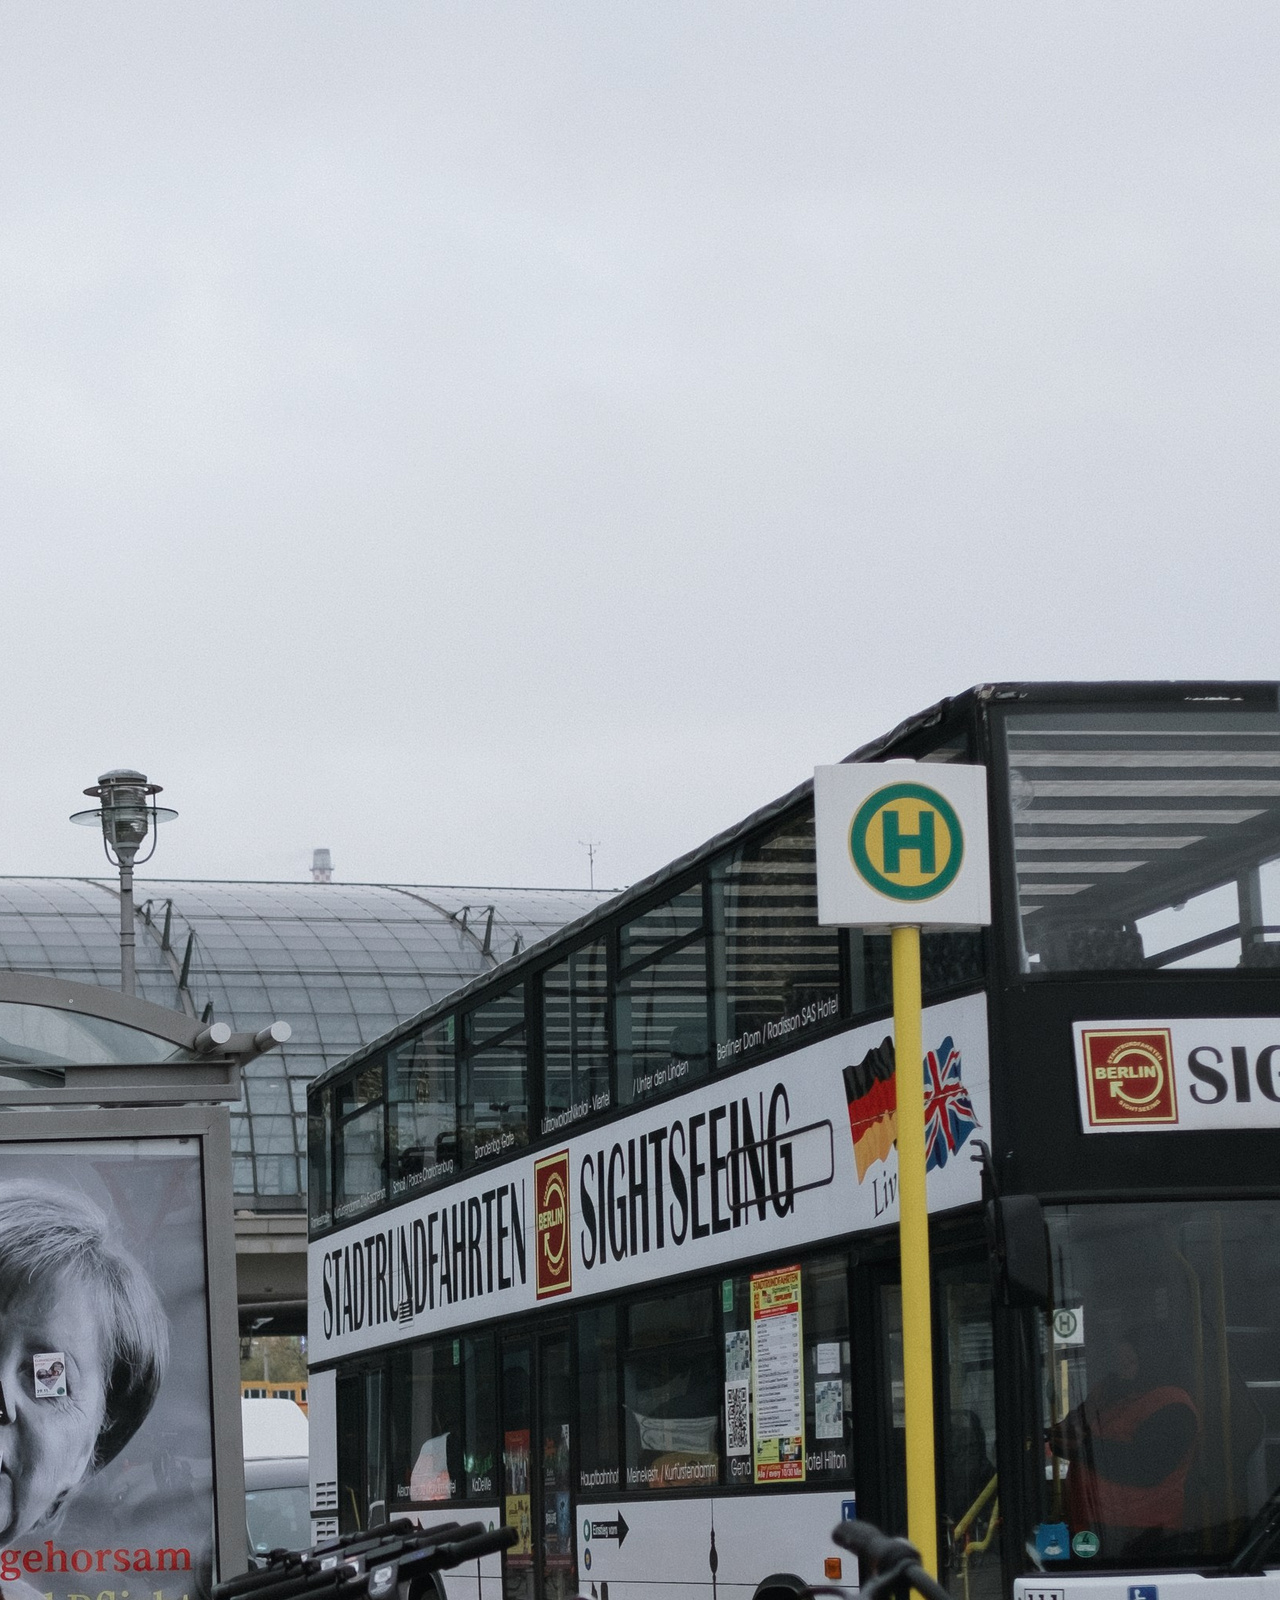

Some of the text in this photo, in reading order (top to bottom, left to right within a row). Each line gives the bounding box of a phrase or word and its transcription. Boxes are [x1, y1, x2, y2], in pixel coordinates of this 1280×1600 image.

[882, 810, 936, 874] H
[716, 1037, 742, 1061] Berliner
[743, 1029, 761, 1050] Dom
[767, 1013, 800, 1041] Radisson
[801, 1005, 817, 1026] SAS
[817, 994, 839, 1020] Hotel
[636, 1074, 653, 1095] Unter
[654, 1068, 667, 1089] den
[667, 1059, 689, 1084] Linden
[1095, 1066, 1156, 1080] BERLIN
[580, 1083, 795, 1271] SIGHTSEEING
[538, 1206, 564, 1231] BERLIN
[323, 1178, 527, 1340] STADTRUNDFAHRTEN
[580, 1468, 620, 1487] Hauptbahnhof
[824, 1450, 847, 1470] Hilton
